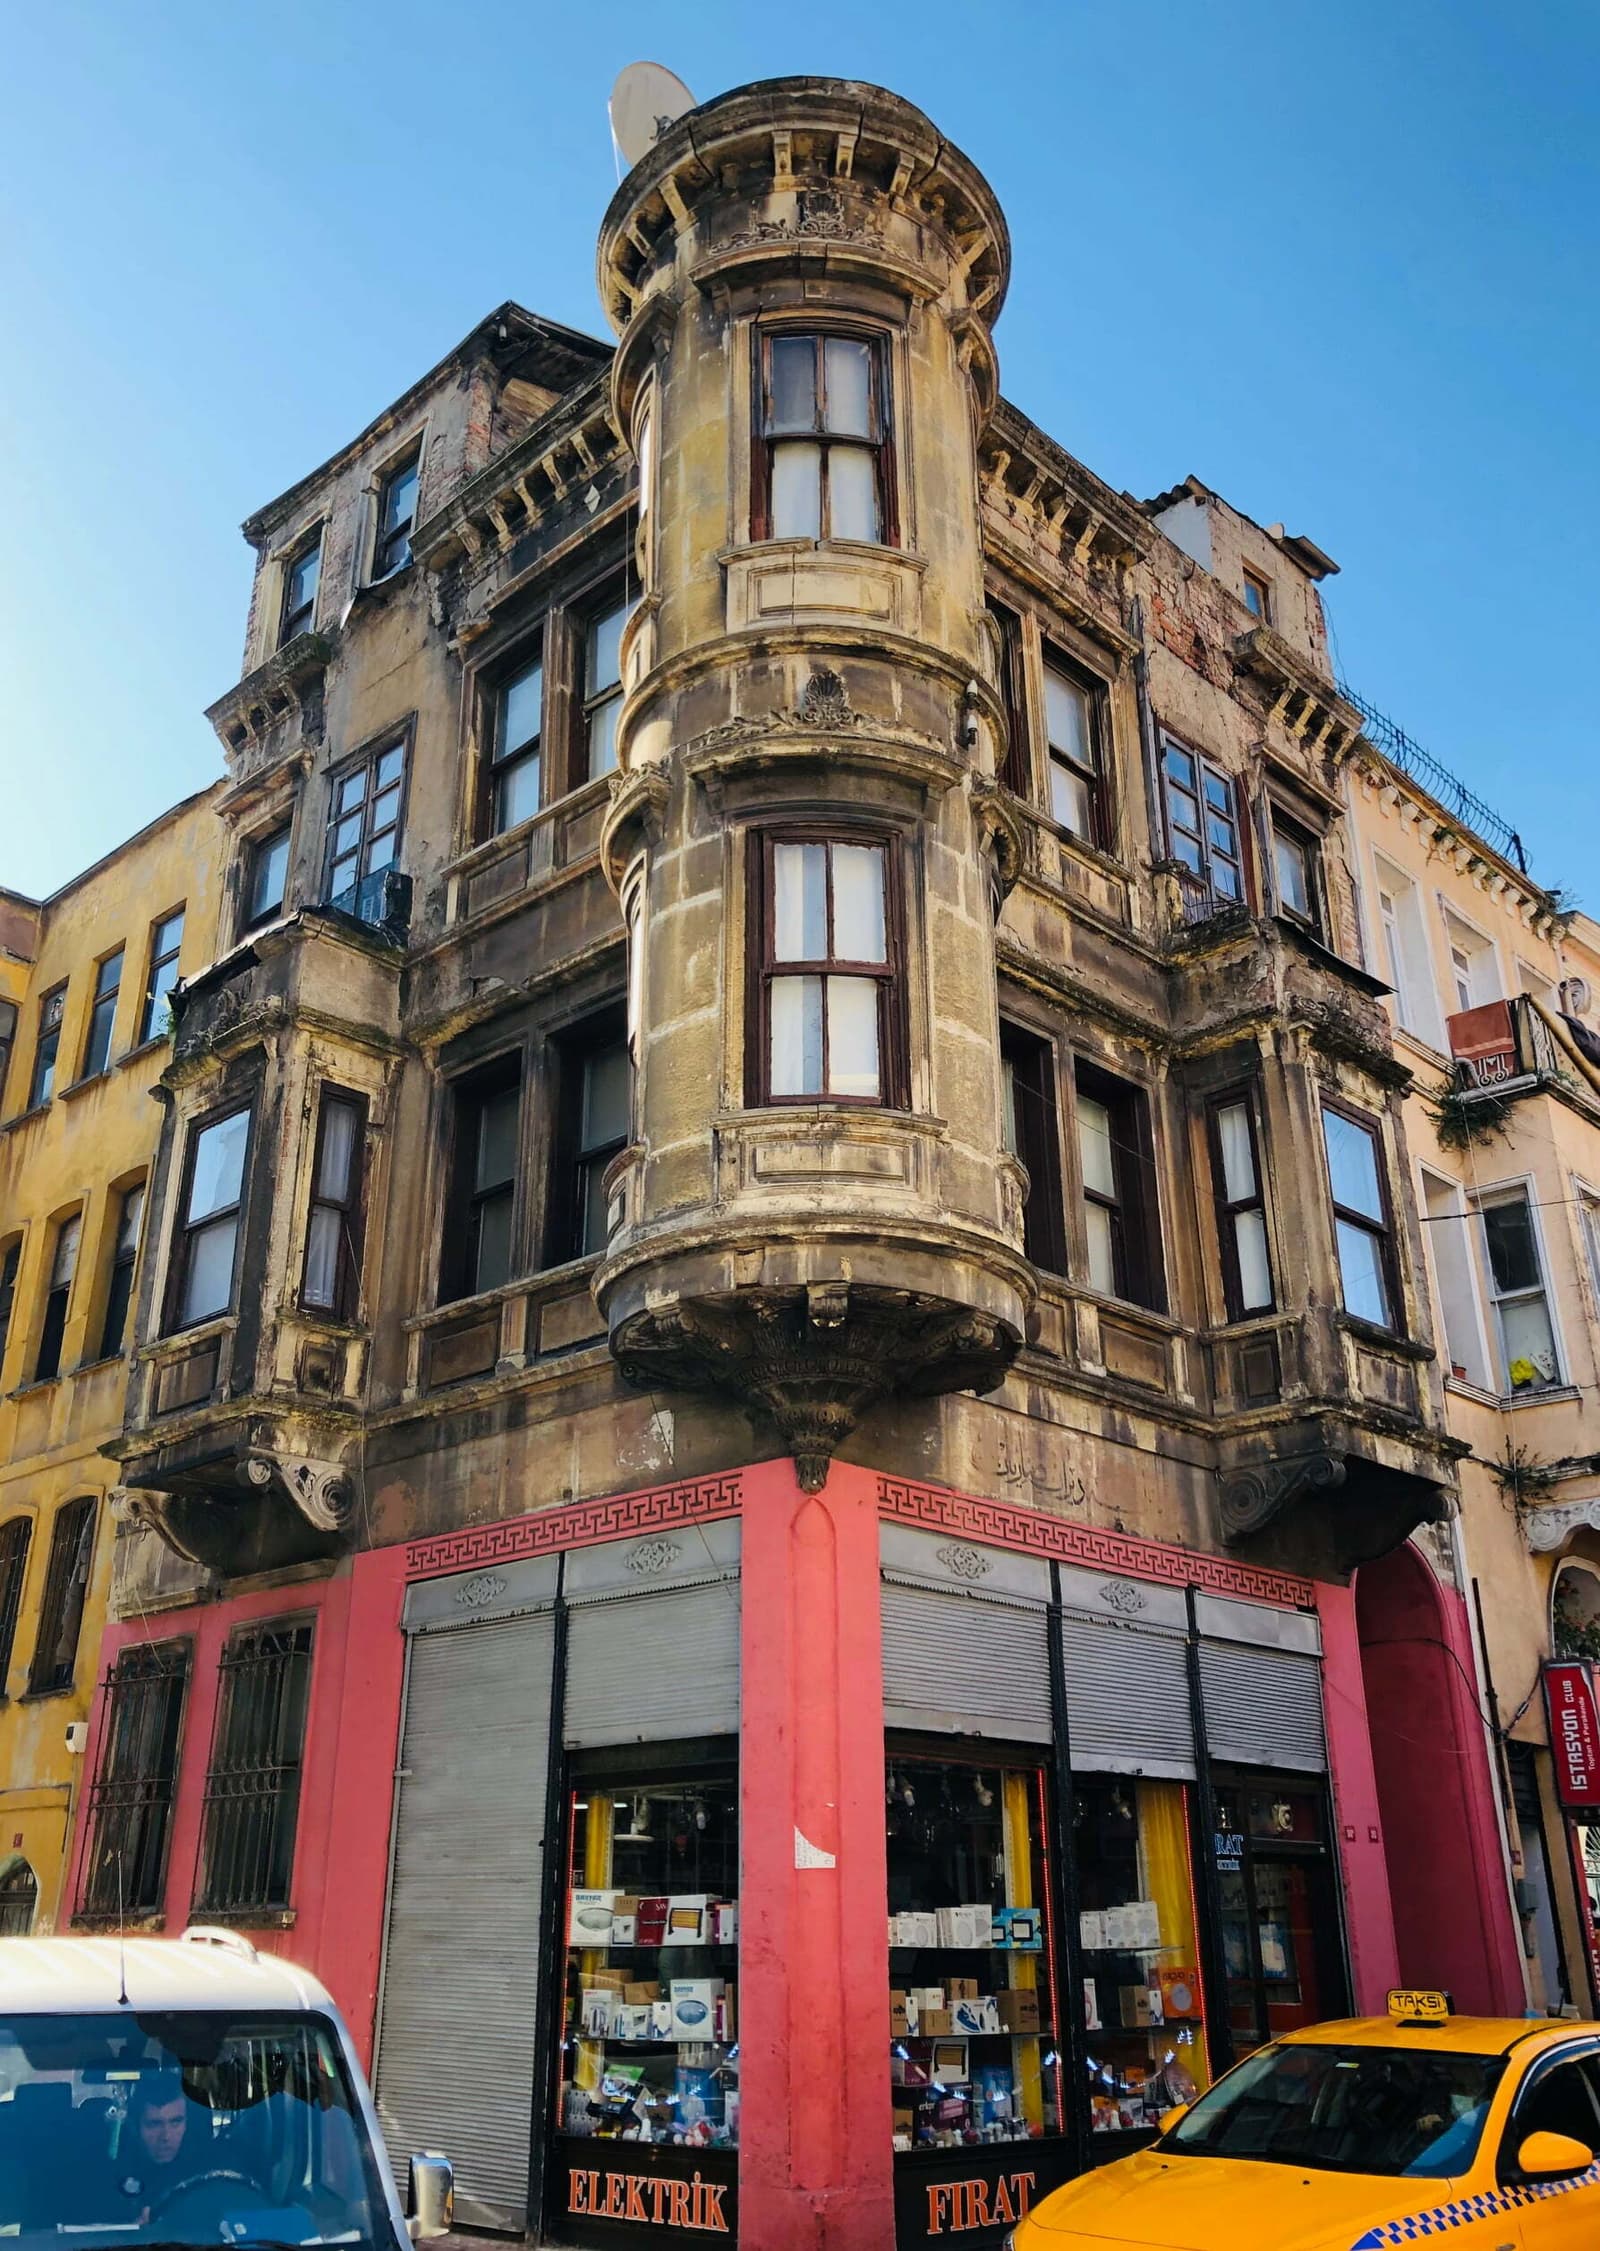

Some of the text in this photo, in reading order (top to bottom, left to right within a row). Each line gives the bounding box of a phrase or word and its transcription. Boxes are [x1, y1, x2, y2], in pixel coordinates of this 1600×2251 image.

[1562, 1680, 1575, 1703] CLUB
[1587, 1744, 1596, 1770] Toptan
[568, 2168, 729, 2232] ELEKTRİK
[926, 2171, 1036, 2235] FIRAT
